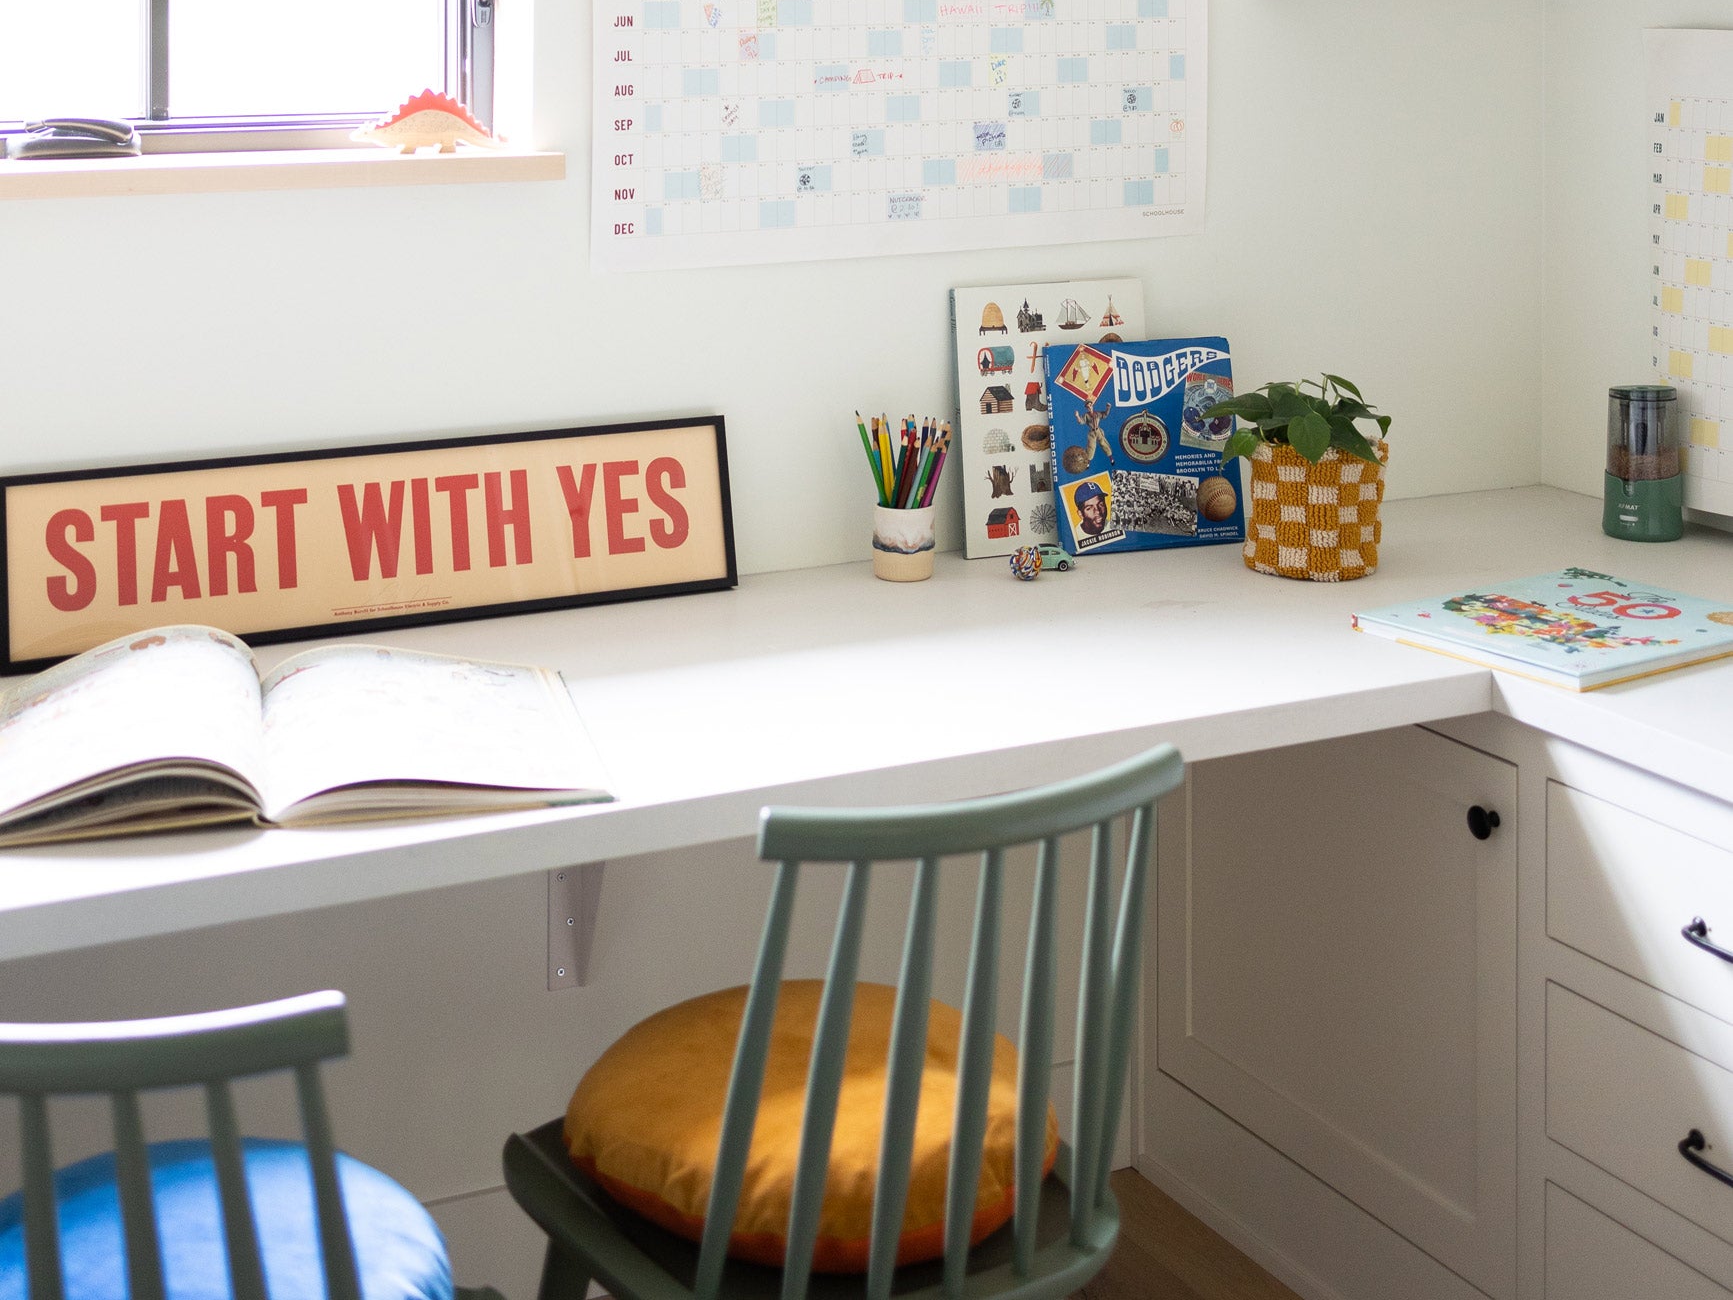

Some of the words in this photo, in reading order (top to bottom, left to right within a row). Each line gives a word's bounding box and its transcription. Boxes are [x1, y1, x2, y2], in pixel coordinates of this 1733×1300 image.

[613, 15, 634, 27] JUN
[614, 50, 633, 62] JUL
[614, 84, 634, 97] AUG
[1654, 112, 1665, 123] JAN
[614, 119, 633, 131] SEP
[1653, 142, 1663, 154] FEB
[614, 154, 634, 166] OCT
[614, 188, 635, 200] NOV
[1142, 208, 1185, 217] SCHOOLHOUSE
[614, 223, 635, 235] DEC
[1118, 359, 1156, 371] THE
[1115, 350, 1217, 402] DODGERS
[1049, 425, 1058, 482] DODGERS
[45, 487, 309, 612] START
[337, 468, 533, 582] WITH
[556, 456, 690, 560] YES
[1081, 537, 1098, 547] JACKIE
[1098, 529, 1121, 542] ROBINSON
[1566, 590, 1683, 620] 50
